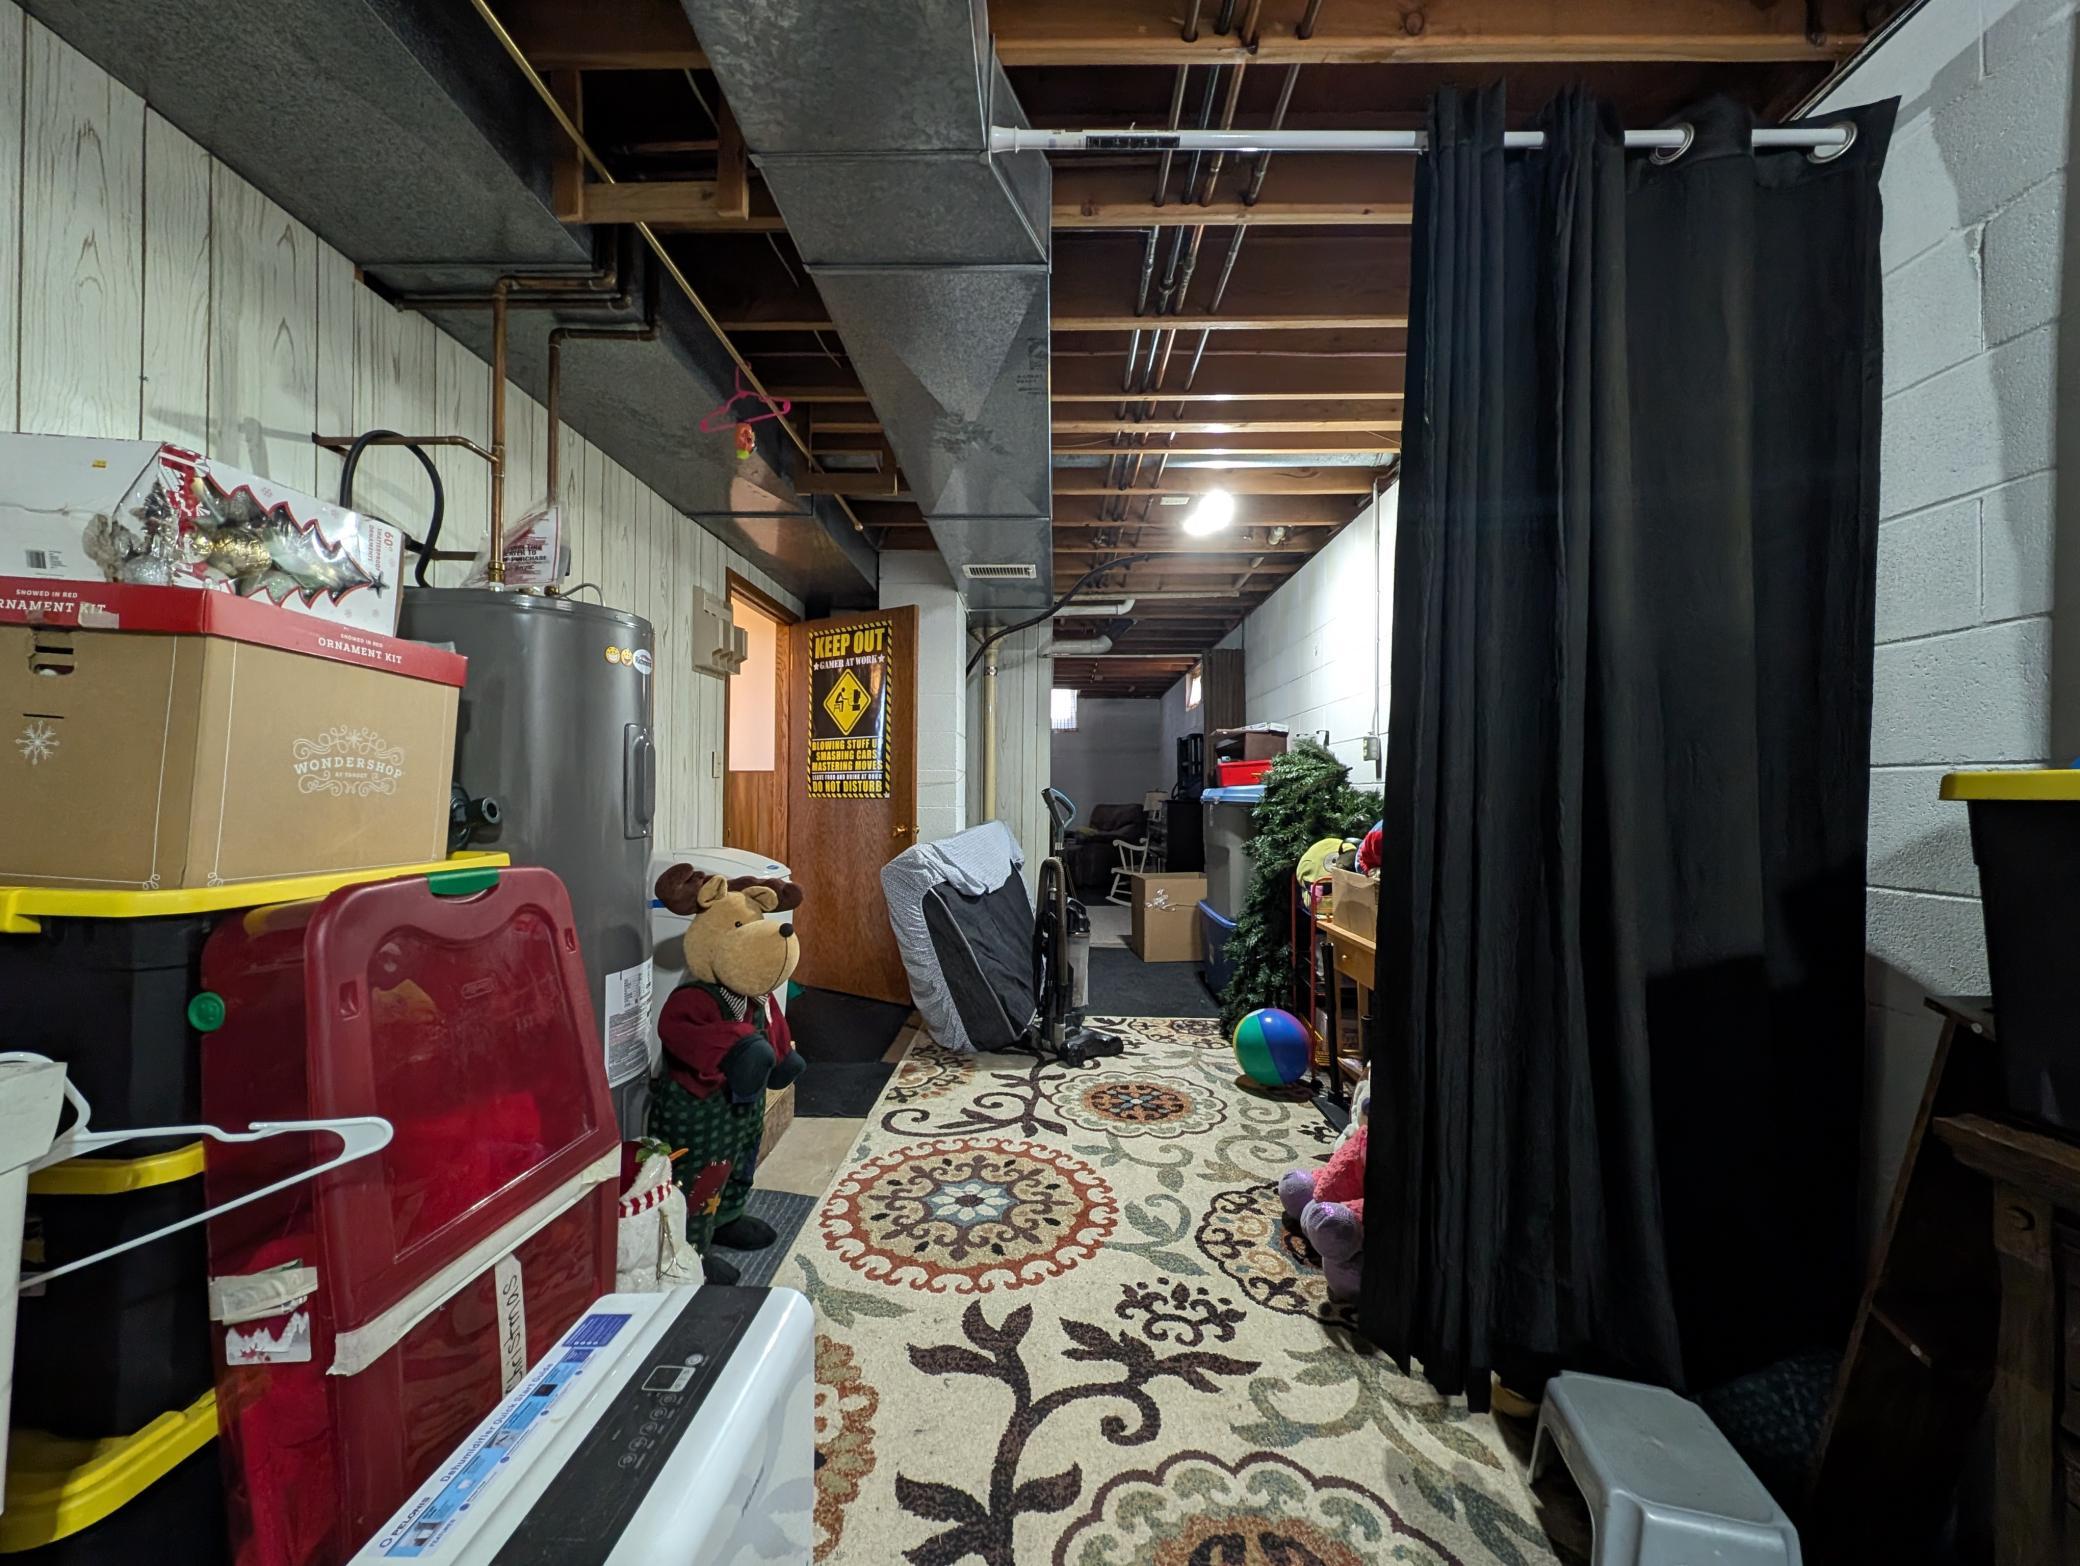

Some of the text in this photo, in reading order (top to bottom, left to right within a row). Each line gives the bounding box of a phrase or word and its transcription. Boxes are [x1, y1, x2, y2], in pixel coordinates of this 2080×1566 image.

[16, 588, 50, 597] SNOWED
[0, 598, 106, 614] RNAMENT KIT
[318, 637, 402, 664] ORNAMENT KIT
[815, 627, 886, 659] KEEP OUT
[820, 654, 878, 670] GAMER AT WORK
[811, 740, 846, 751] BLOWING
[846, 738, 870, 750] STUFF
[815, 749, 878, 761] SMASHING CARS
[293, 756, 402, 778] WONDERSHOP
[811, 759, 883, 772] MASTERING MOVES
[812, 780, 883, 793] DO NOT DISTURB
[440, 1424, 496, 1482] Dehumidifier
[494, 1403, 515, 1425] Quick
[512, 1383, 534, 1403] Start
[531, 1362, 554, 1383] Guide
[391, 1496, 431, 1536] PELONIS
